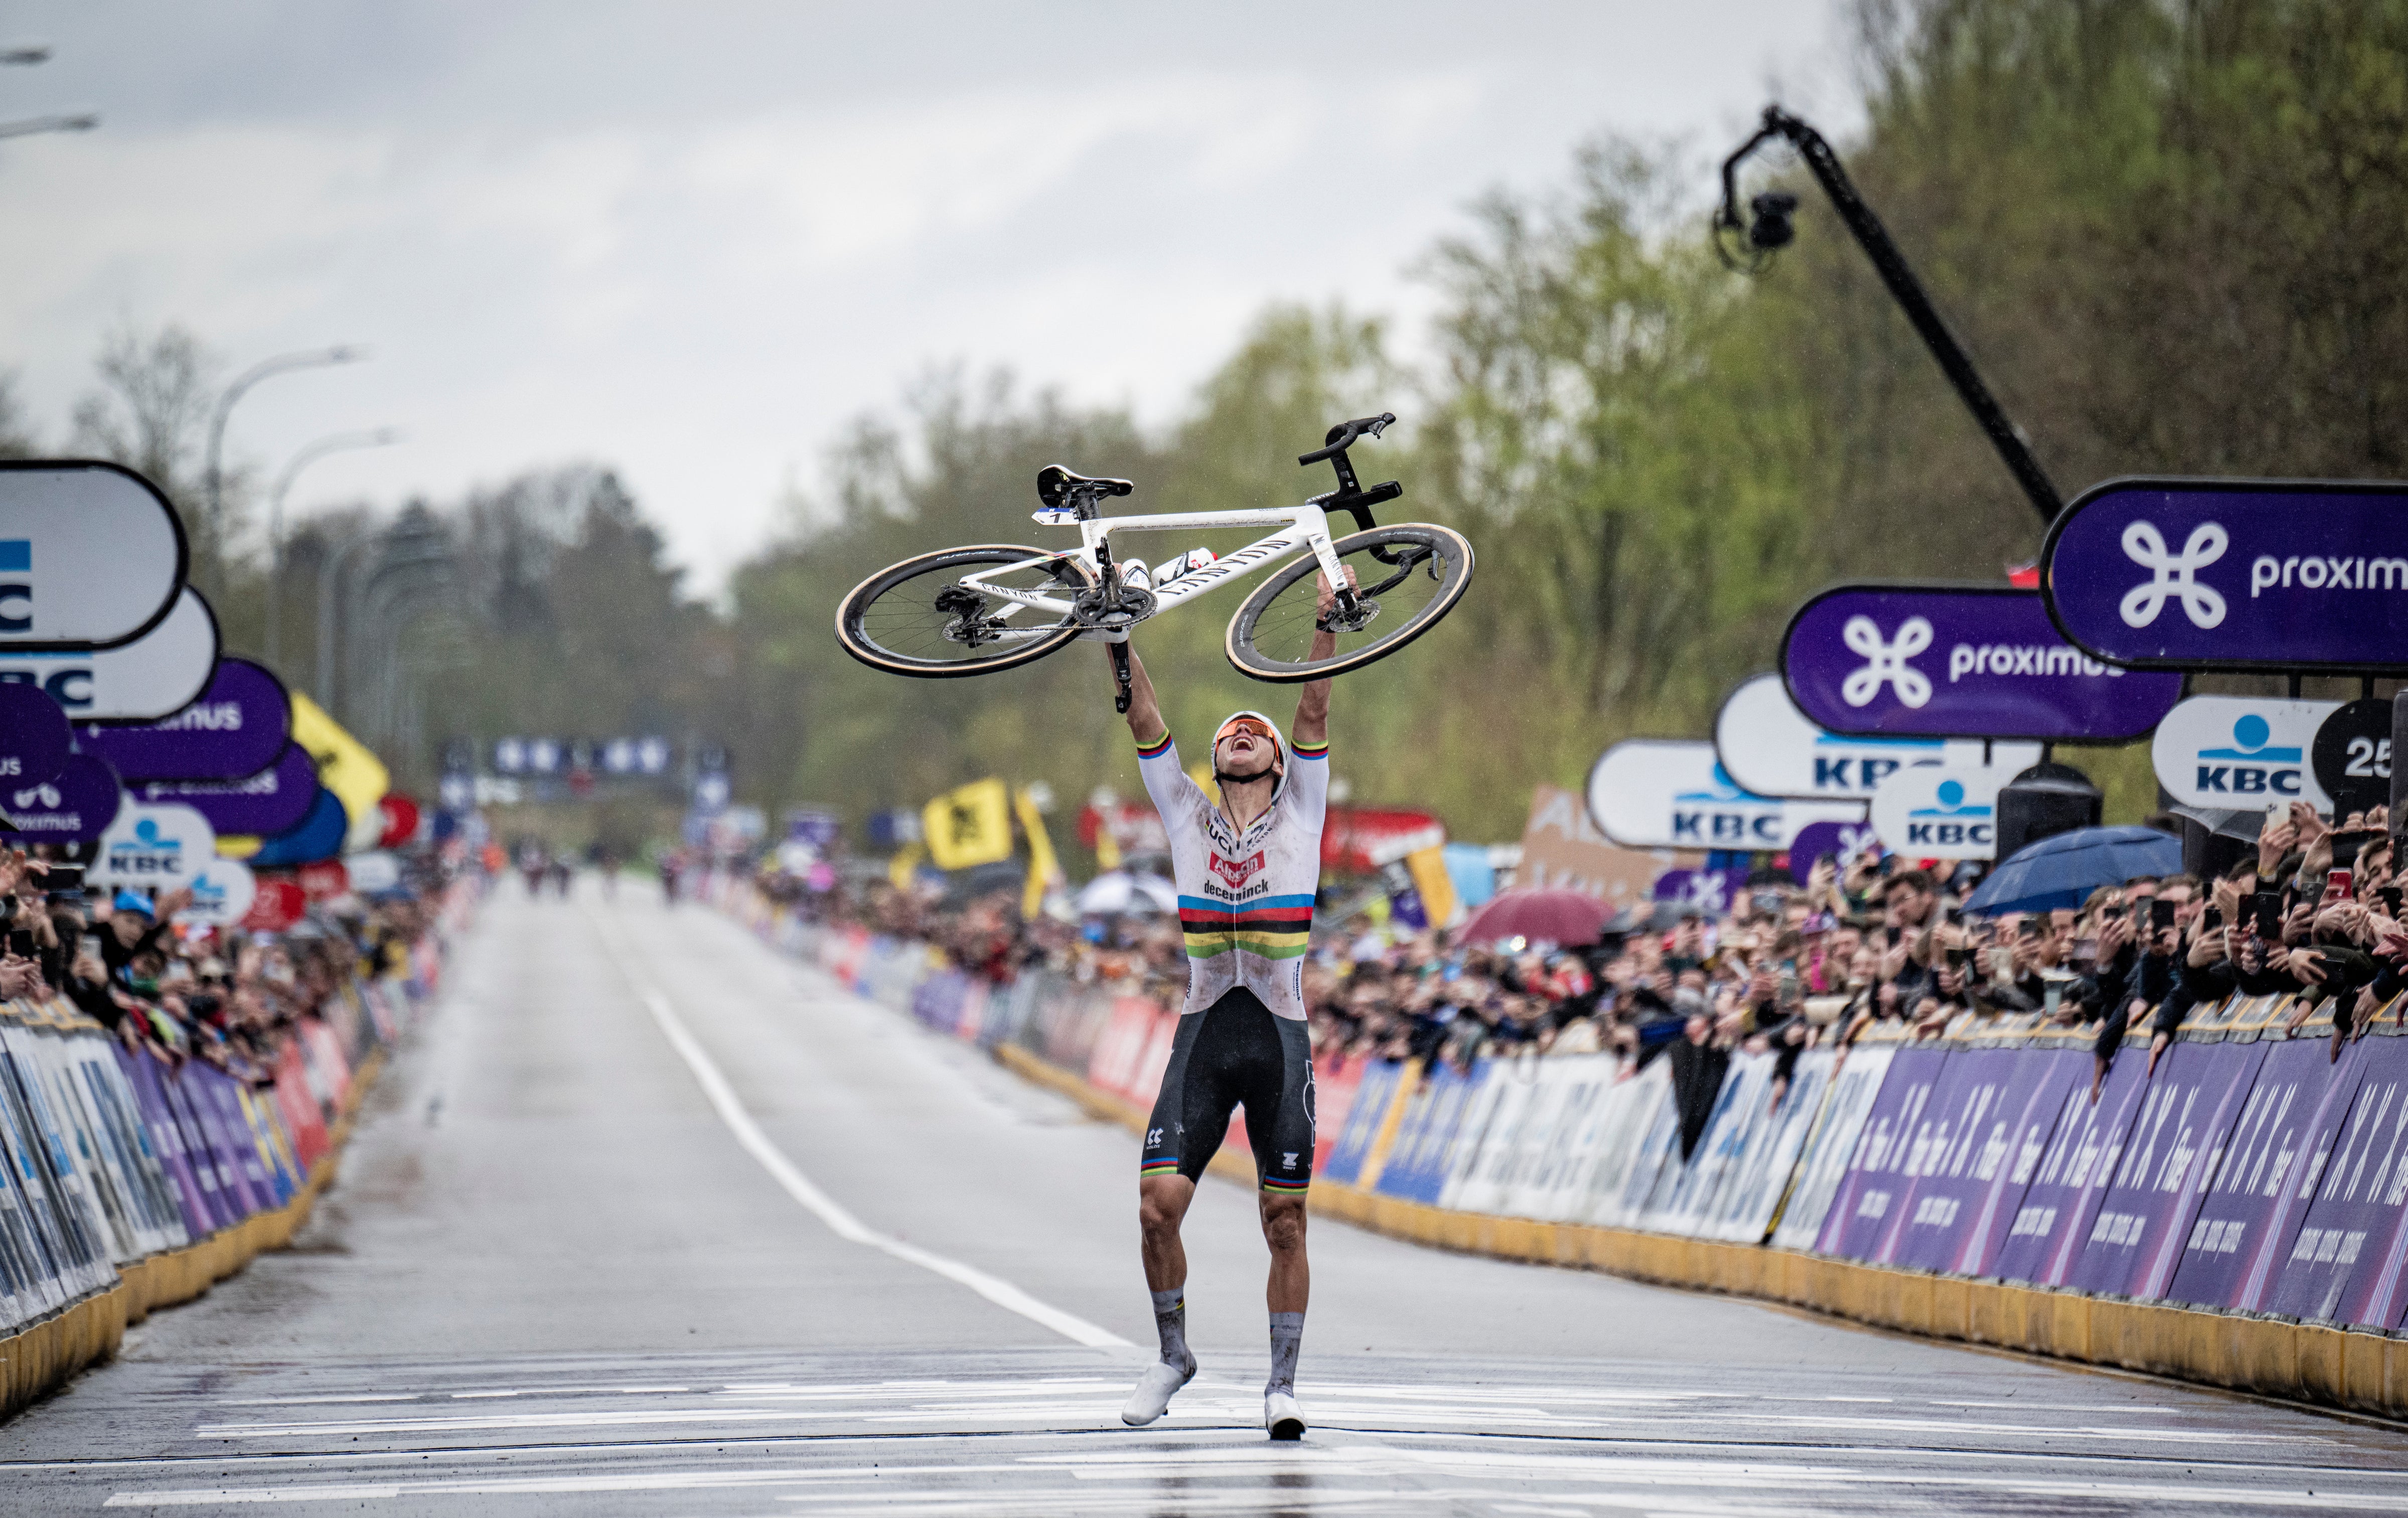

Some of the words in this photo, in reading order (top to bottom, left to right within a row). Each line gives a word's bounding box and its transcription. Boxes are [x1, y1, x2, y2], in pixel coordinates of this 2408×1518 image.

[1049, 513, 1061, 523] 1
[936, 551, 1000, 561] DURA-ACE
[1156, 540, 1292, 595] CANYON
[1328, 554, 1345, 580] CANYON
[981, 583, 1037, 601] CANYON
[2345, 736, 2390, 778] 25
[2196, 766, 2301, 797] KBC
[1673, 812, 1784, 841] KBC
[1909, 823, 1993, 846] KBC
[1209, 823, 1232, 856] UCI
[109, 855, 182, 874] KBC
[1215, 857, 1259, 881] Alpecin
[1204, 879, 1269, 902] deceuninck
